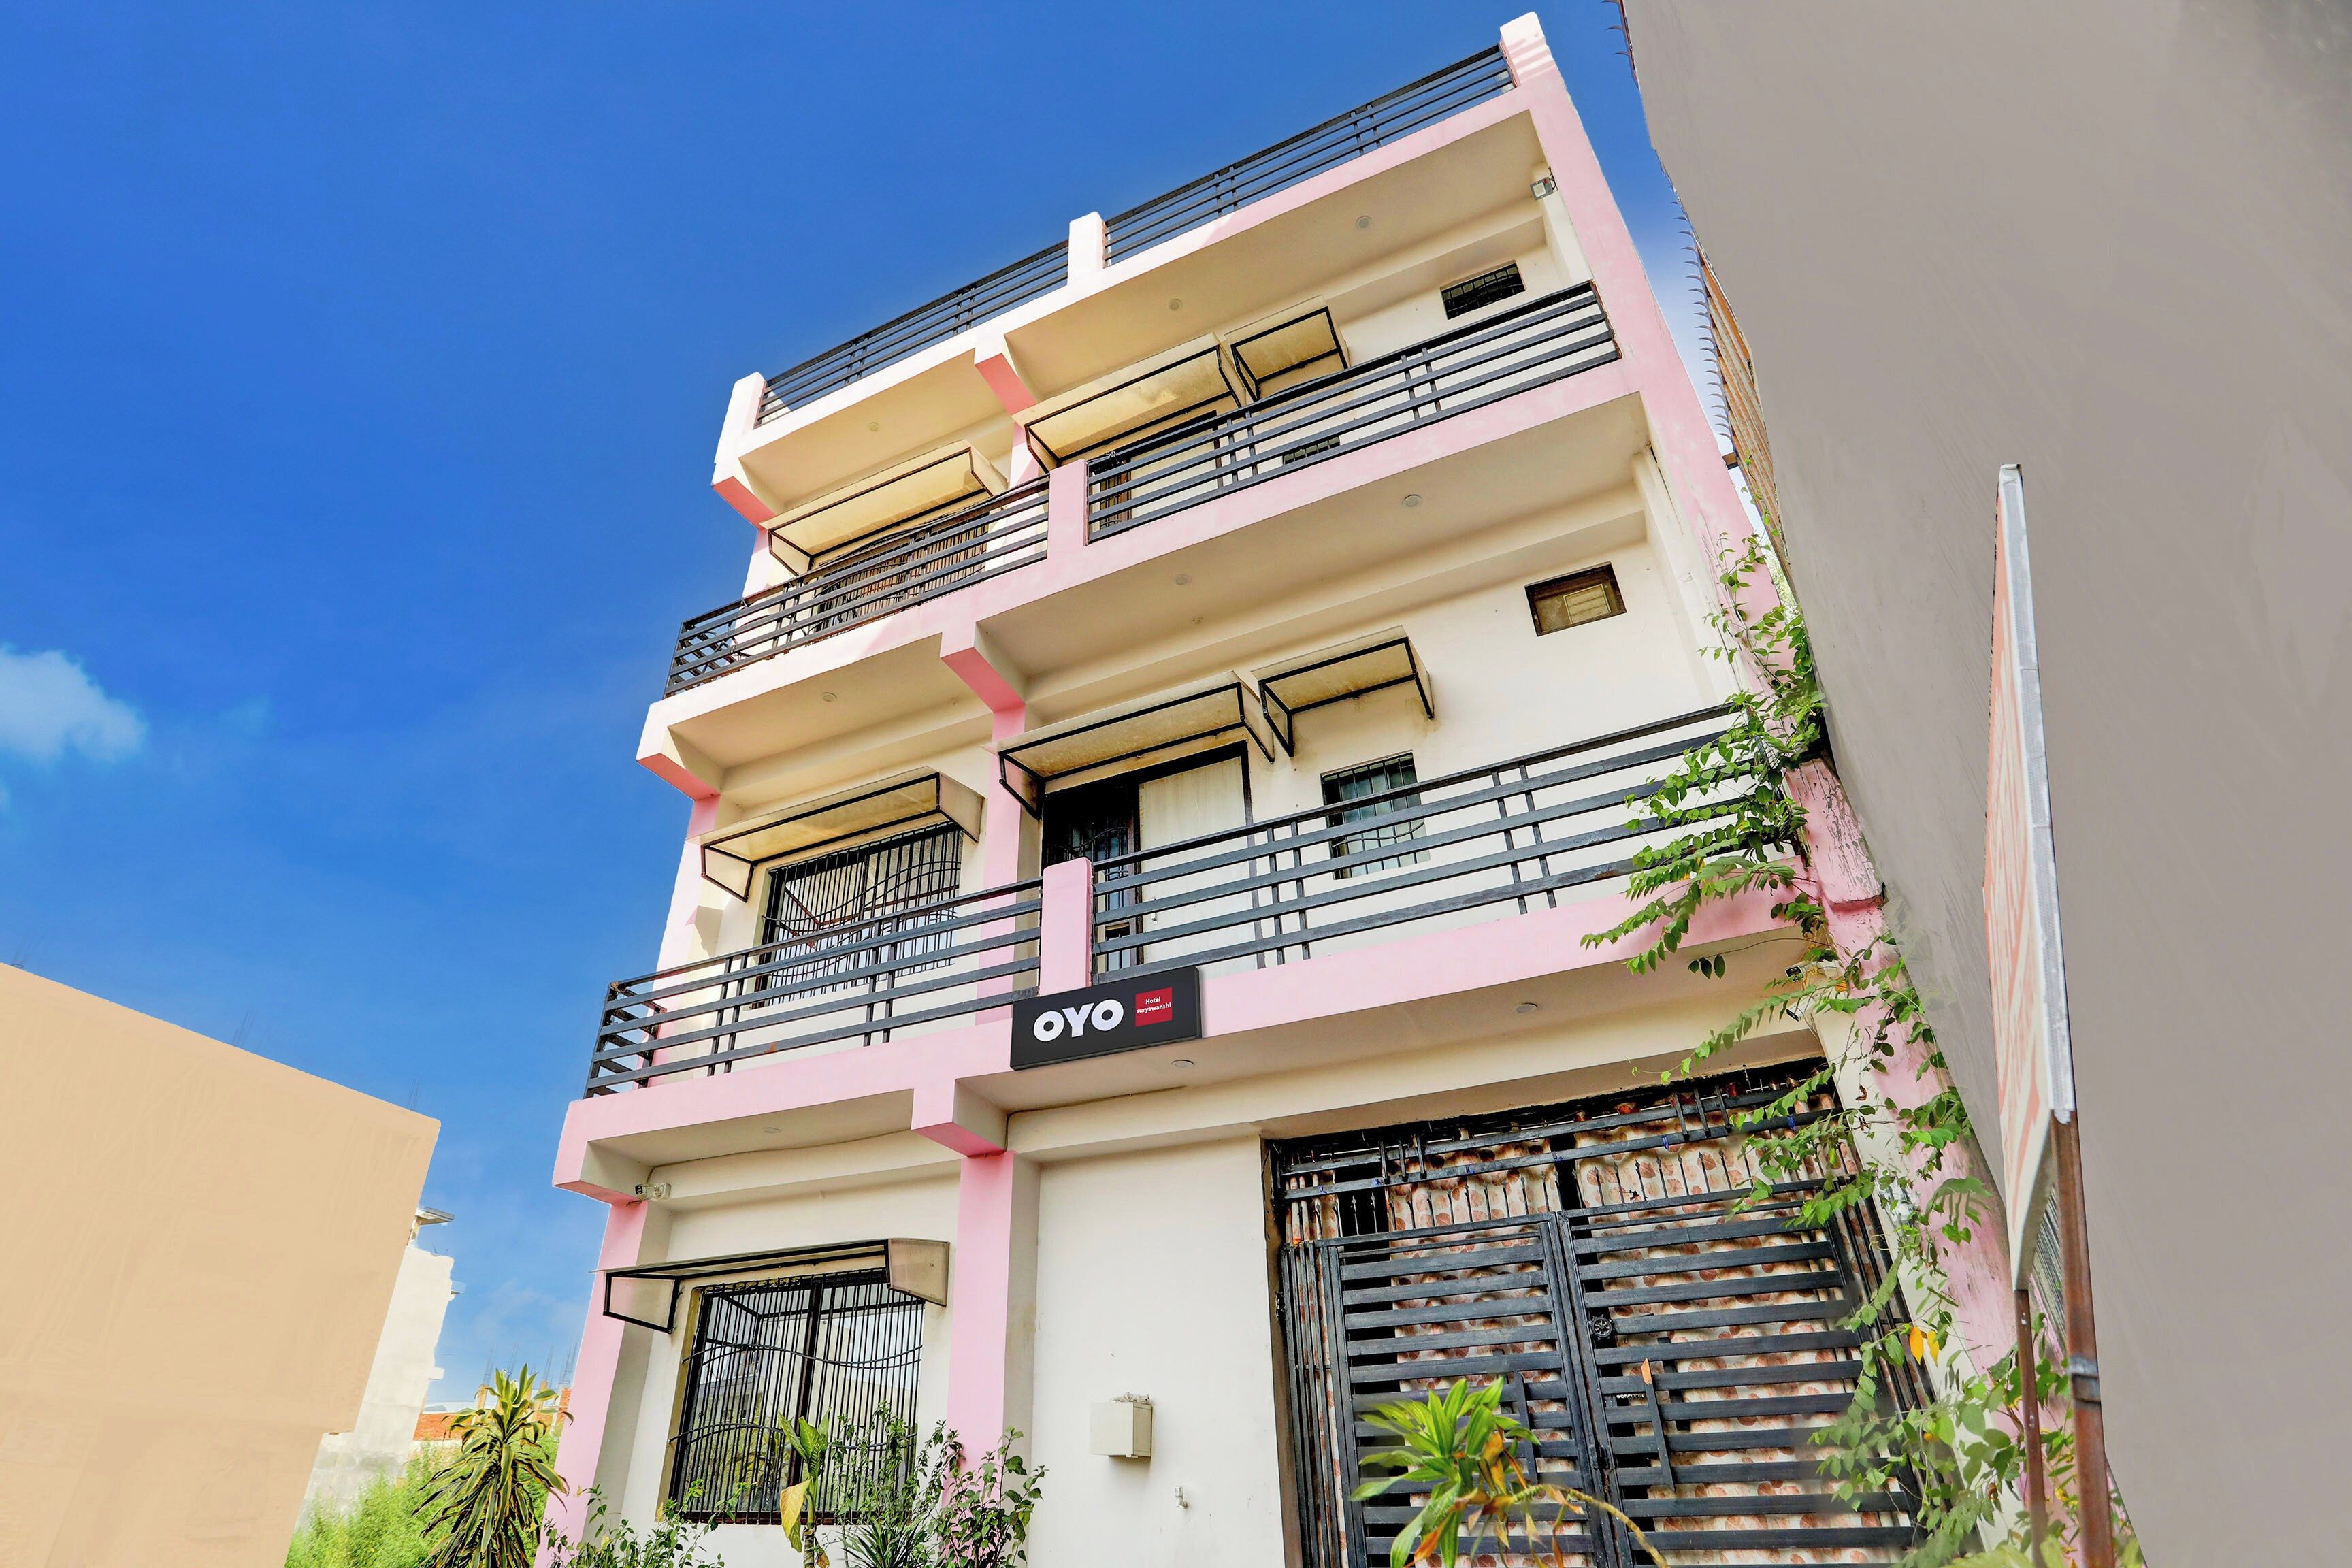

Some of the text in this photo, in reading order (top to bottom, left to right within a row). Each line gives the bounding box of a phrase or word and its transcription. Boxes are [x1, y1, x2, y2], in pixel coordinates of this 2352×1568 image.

[1145, 996, 1161, 1004] Hotel
[1136, 1002, 1172, 1014] suryawanshi
[1033, 999, 1124, 1042] OYO
